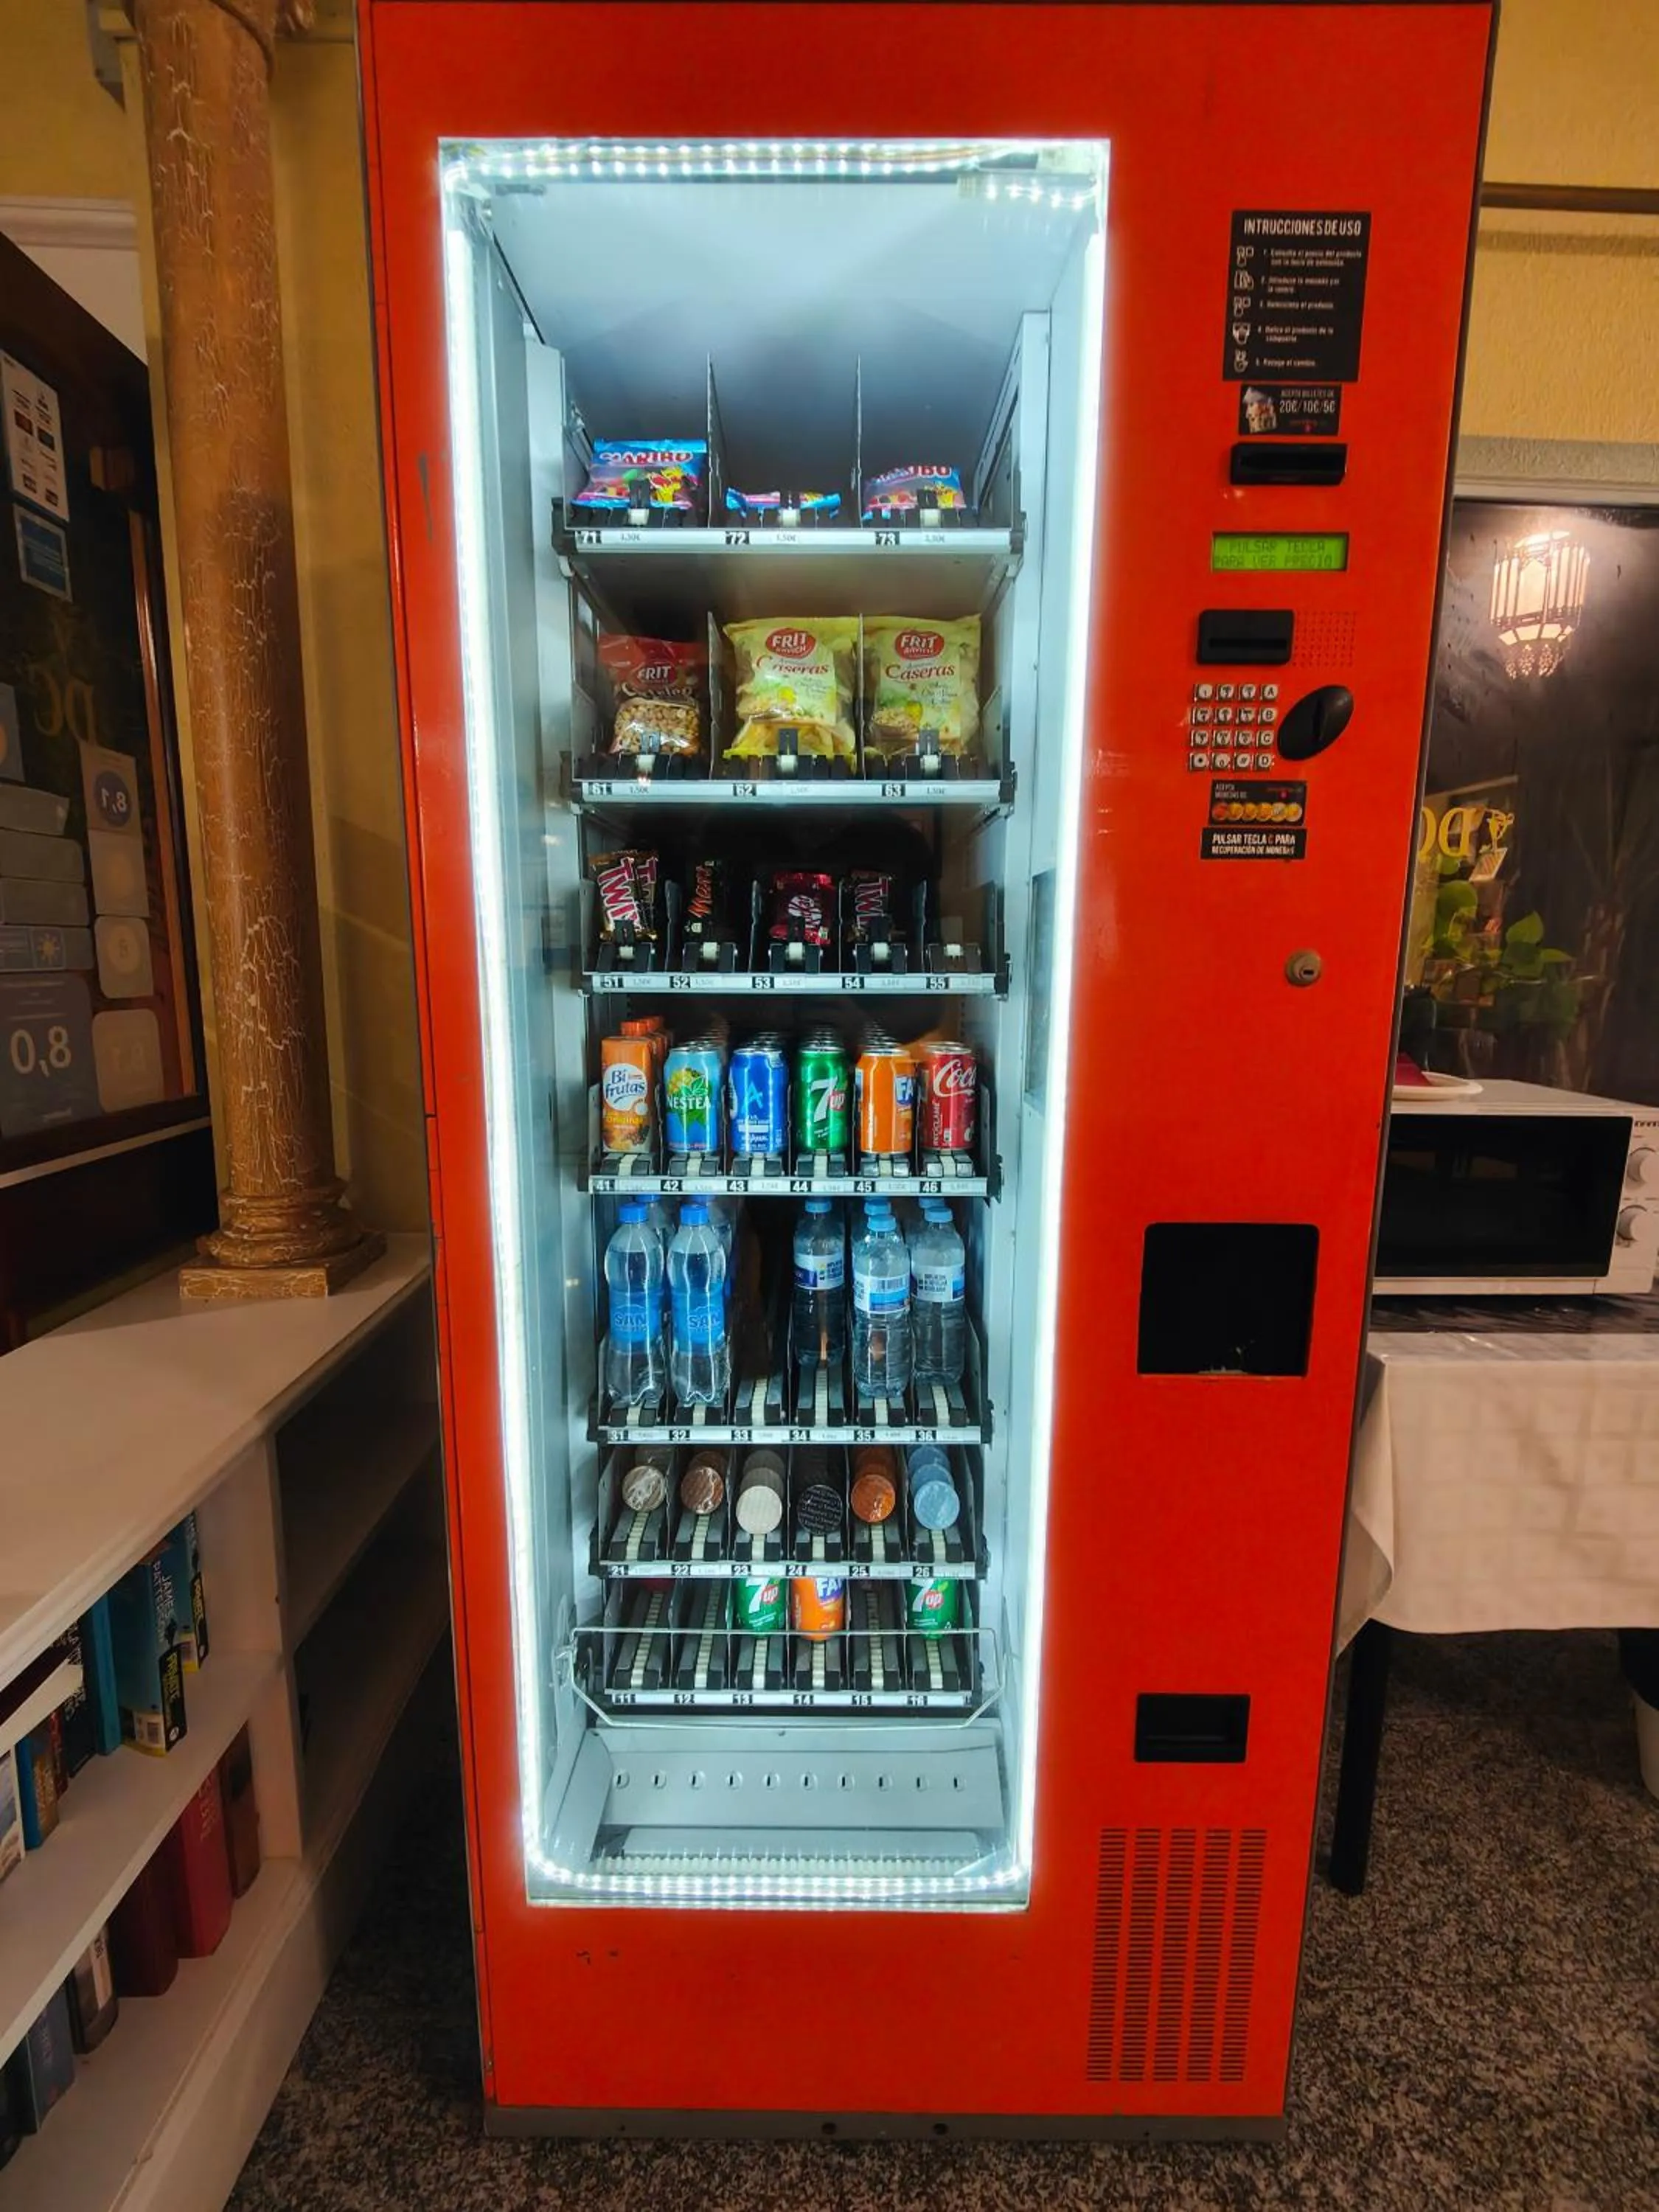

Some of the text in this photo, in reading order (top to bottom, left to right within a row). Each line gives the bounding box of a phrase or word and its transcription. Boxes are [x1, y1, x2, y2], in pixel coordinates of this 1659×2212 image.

[1244, 218, 1362, 236] INTRUCCIONES DE USO
[583, 531, 599, 543] 71
[731, 532, 746, 544] 72
[878, 532, 896, 545] 73
[771, 632, 807, 648] FRIT
[900, 635, 938, 649] FRIT
[636, 665, 672, 680] FRIT
[886, 664, 955, 681] Caseras
[593, 783, 608, 795] 61
[736, 784, 753, 796] 62
[885, 784, 902, 796] 63
[1212, 833, 1242, 844] PULSAR
[1244, 833, 1267, 844] TECLA
[1275, 834, 1296, 845] PARA
[605, 975, 619, 988] 51
[672, 976, 689, 989] 52
[755, 977, 771, 989] 53
[845, 977, 860, 989] 54
[929, 977, 945, 990] 55
[611, 1069, 626, 1085] Bi
[606, 1082, 645, 1099] frutas
[667, 1096, 712, 1110] NESTEA
[811, 1076, 838, 1123] 7
[596, 1180, 611, 1191] 41
[663, 1180, 679, 1191] 42
[729, 1180, 745, 1192] 43
[793, 1181, 808, 1192] 44
[857, 1181, 872, 1192] 45
[922, 1181, 938, 1193] 46
[611, 1430, 624, 1441] 31
[672, 1430, 686, 1441] 32
[734, 1430, 748, 1441] 33
[793, 1430, 807, 1441] 34
[857, 1430, 872, 1441] 35
[919, 1430, 933, 1441] 36
[611, 1565, 625, 1576] 21
[674, 1565, 689, 1576] 22
[734, 1565, 748, 1576] 23
[789, 1565, 803, 1576] 24
[852, 1565, 868, 1577] 25
[915, 1567, 931, 1577] 26
[745, 1577, 771, 1613] 7
[911, 1578, 935, 1613] 7
[678, 1694, 692, 1704] 12
[736, 1694, 751, 1705] 13
[796, 1694, 810, 1705] 14
